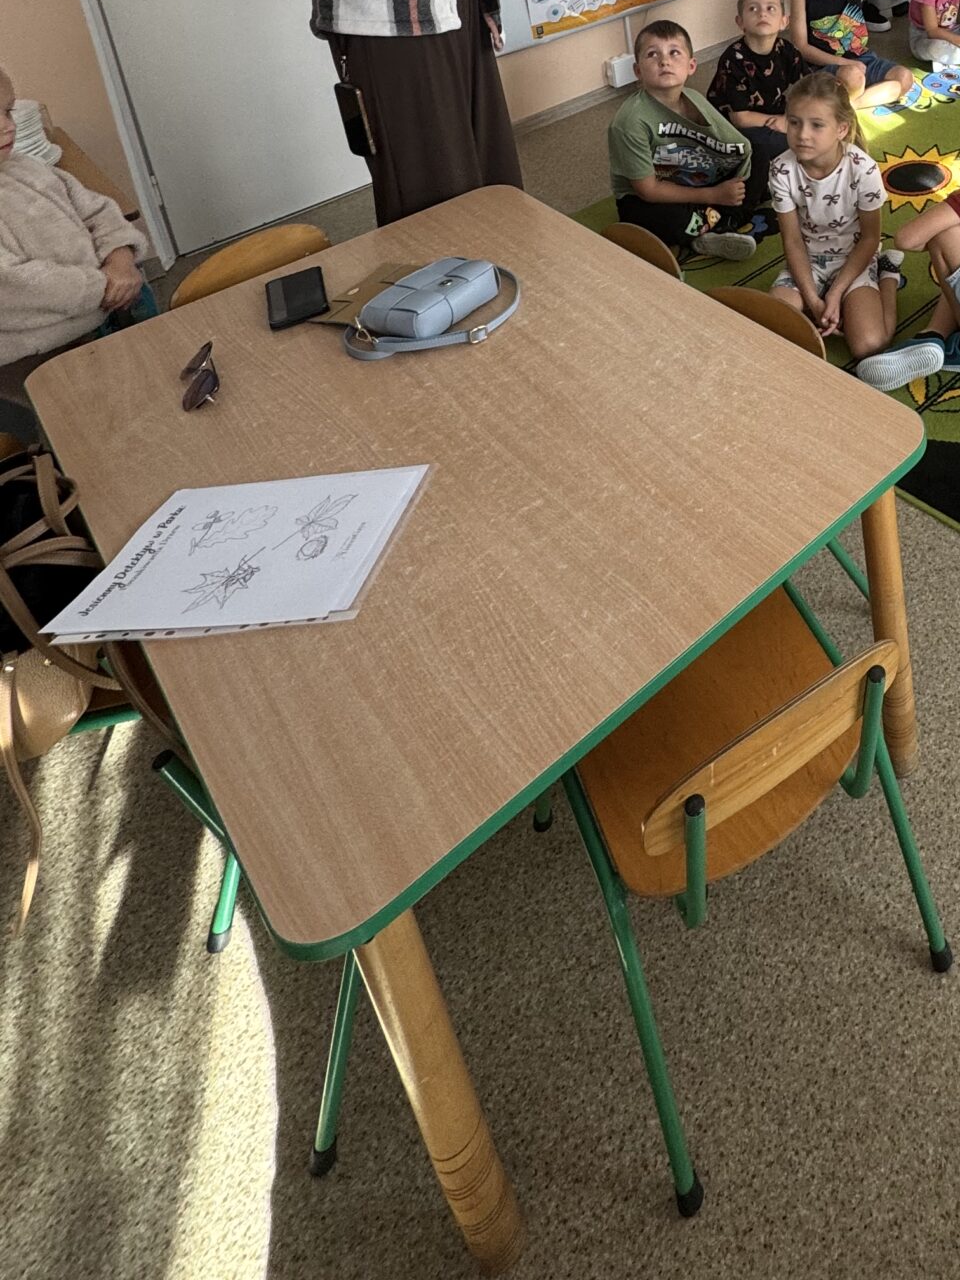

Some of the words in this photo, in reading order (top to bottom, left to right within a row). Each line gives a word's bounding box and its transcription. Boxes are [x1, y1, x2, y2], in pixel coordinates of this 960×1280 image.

[658, 122, 745, 154] MINECRAFT
[78, 582, 126, 616] Jesienny
[114, 540, 156, 579] Detektyw
[153, 530, 164, 539] w
